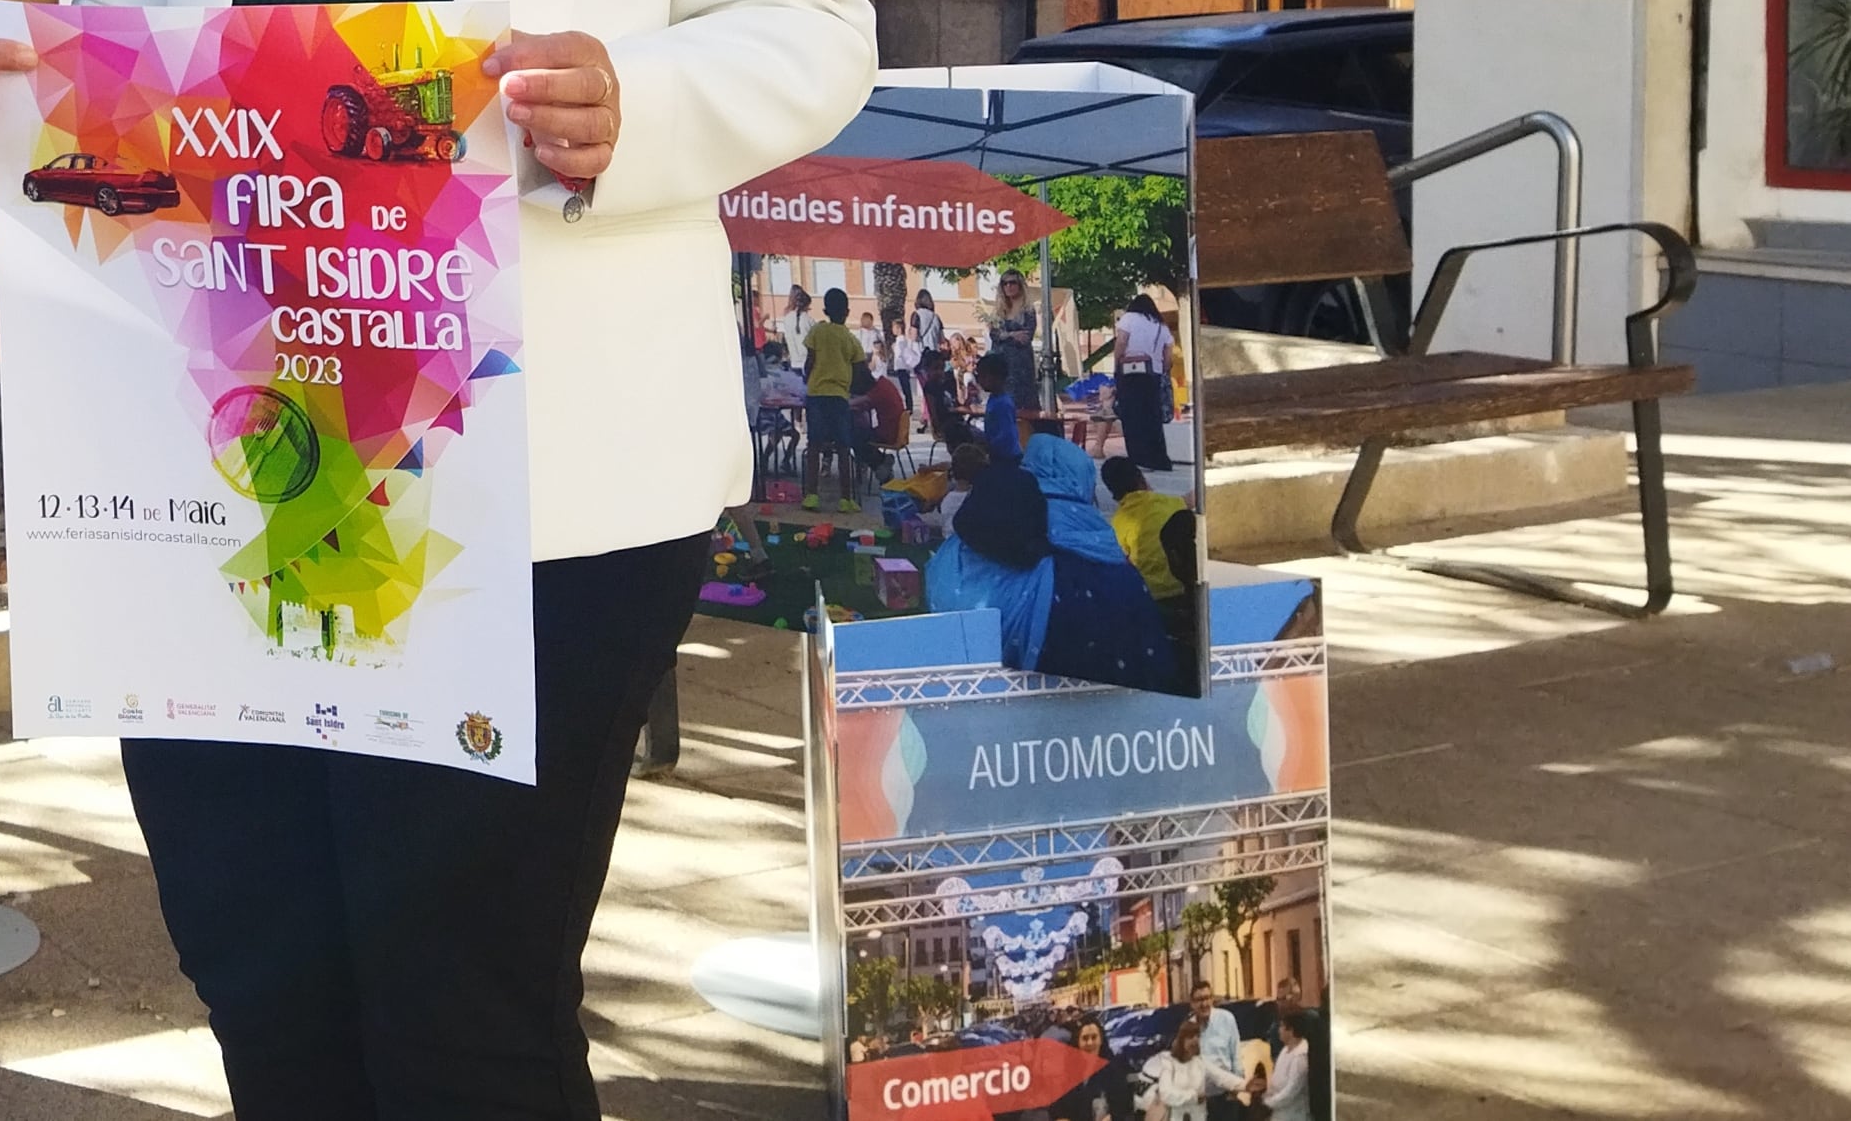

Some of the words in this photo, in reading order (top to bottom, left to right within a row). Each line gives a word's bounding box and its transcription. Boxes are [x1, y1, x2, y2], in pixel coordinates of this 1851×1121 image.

[171, 106, 283, 160] XXIX
[722, 190, 844, 224] vidades
[852, 195, 1016, 235] infantiles
[275, 353, 343, 385] 2023
[26, 527, 242, 548] www.feriasanisidrocastalla.com
[244, 715, 286, 723] VALENCIANA
[306, 716, 321, 726] Sant
[324, 718, 344, 729] Isidre
[968, 718, 1216, 790] AUTOMOCIÓN
[883, 1062, 1030, 1110] Comercio
